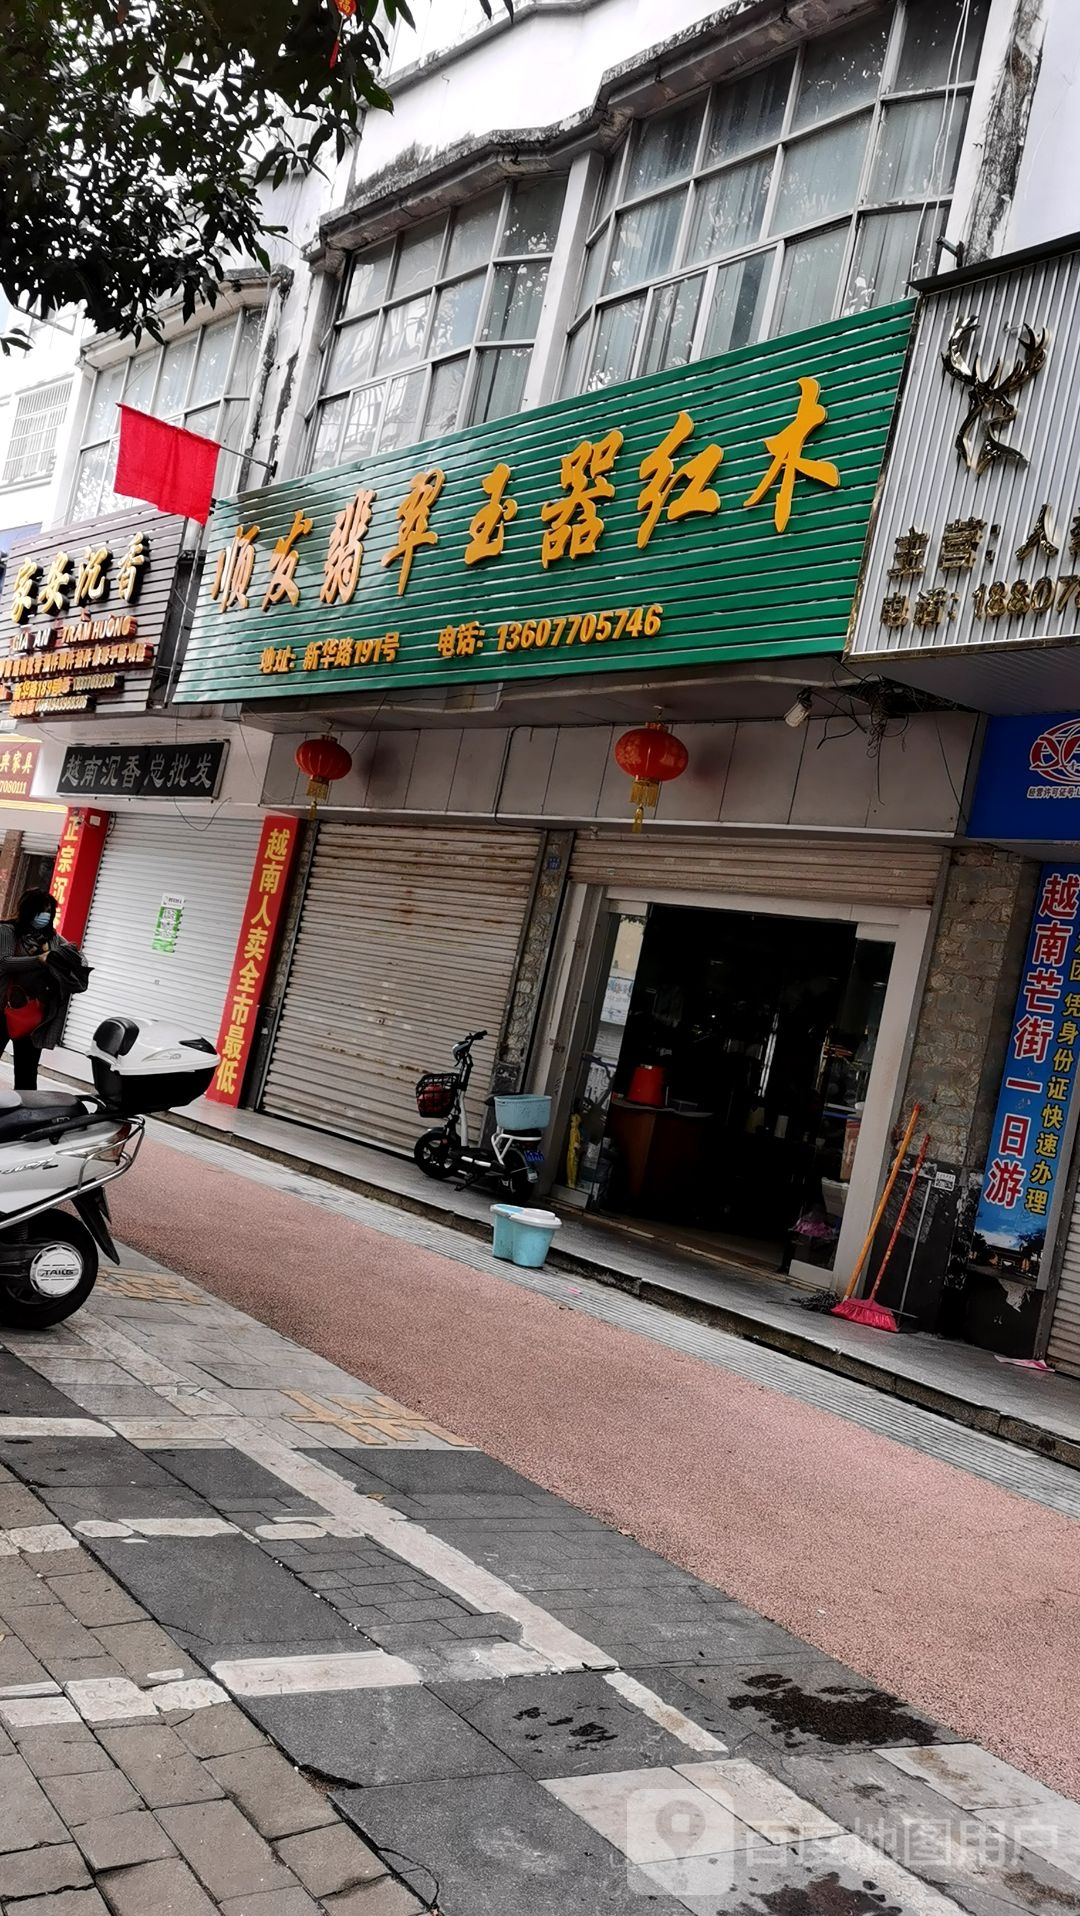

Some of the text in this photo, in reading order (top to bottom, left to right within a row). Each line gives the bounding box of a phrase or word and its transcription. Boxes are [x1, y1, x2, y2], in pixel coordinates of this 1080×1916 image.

[211, 375, 840, 612] 顺发翡翠玉器红木
[1014, 503, 1080, 561] 人
[302, 631, 400, 672] 新华路191号
[496, 603, 664, 653] 13607705746
[61, 752, 213, 789] 越南沉香总批发
[215, 828, 291, 1095] 越南人卖全市最低
[983, 873, 1080, 1210] 越南芒街一日游
